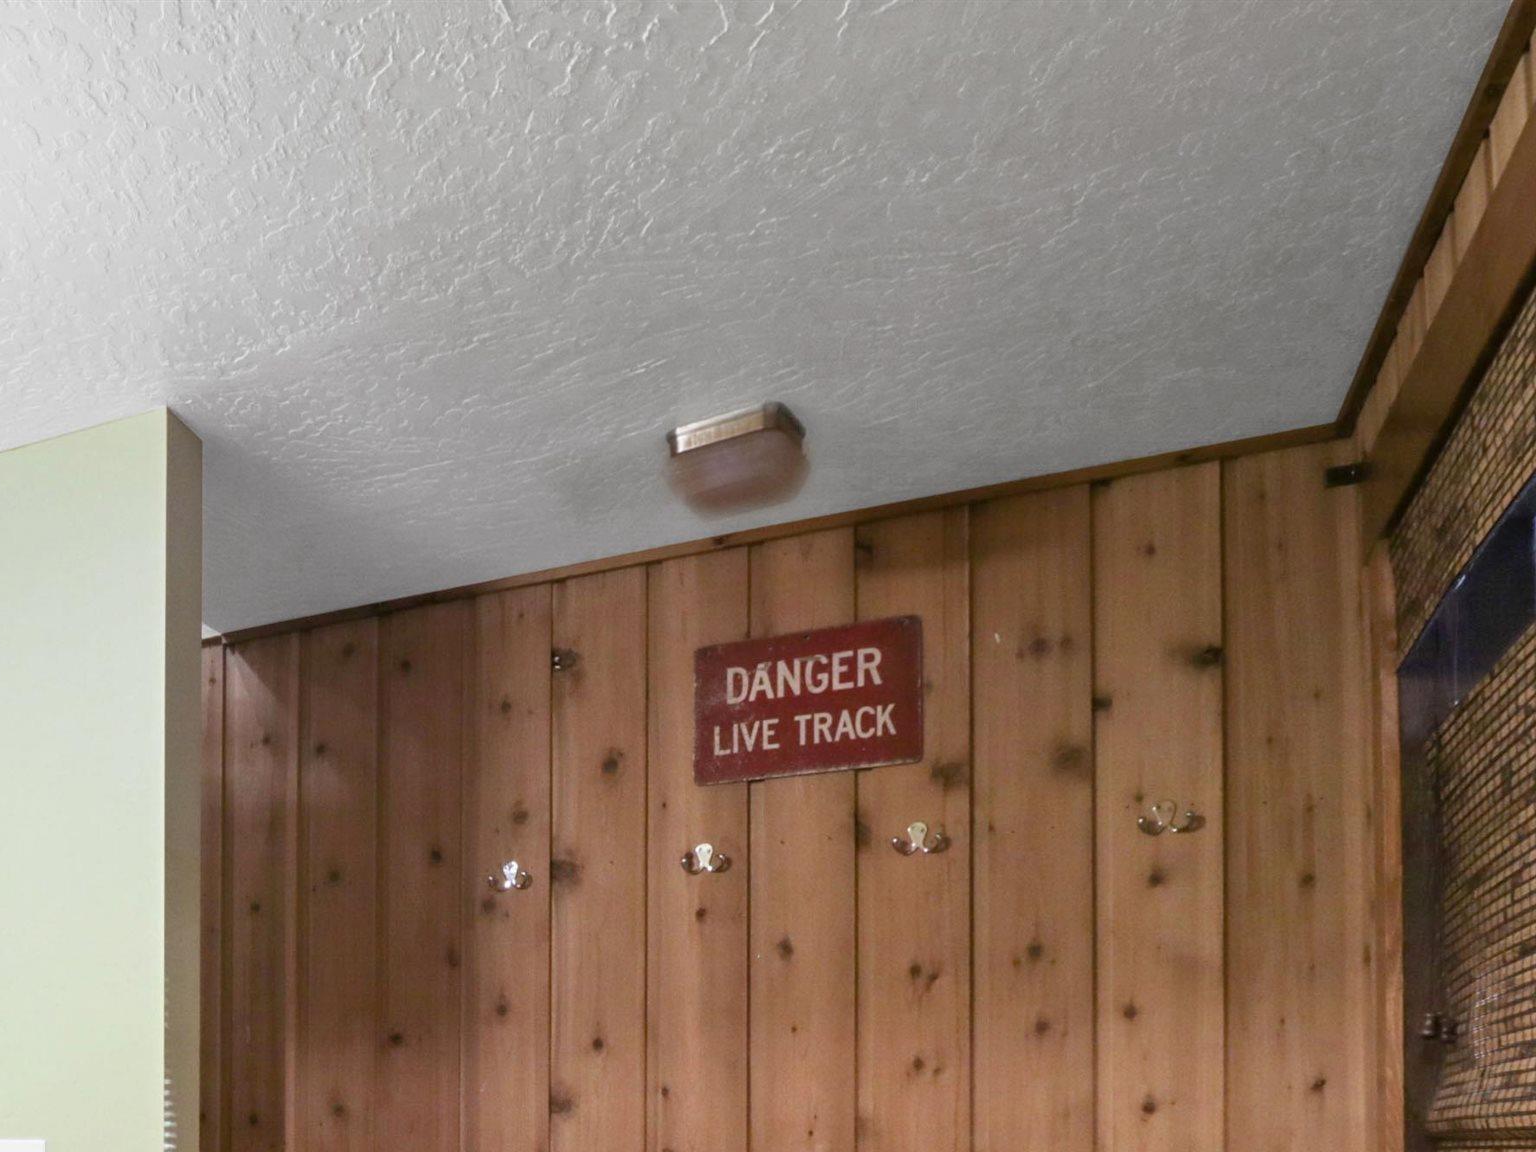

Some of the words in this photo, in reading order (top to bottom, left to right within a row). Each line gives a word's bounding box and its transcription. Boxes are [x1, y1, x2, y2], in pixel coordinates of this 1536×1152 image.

[726, 647, 883, 705] DANGER
[714, 718, 780, 756] LIVE
[794, 703, 897, 746] TRACK
